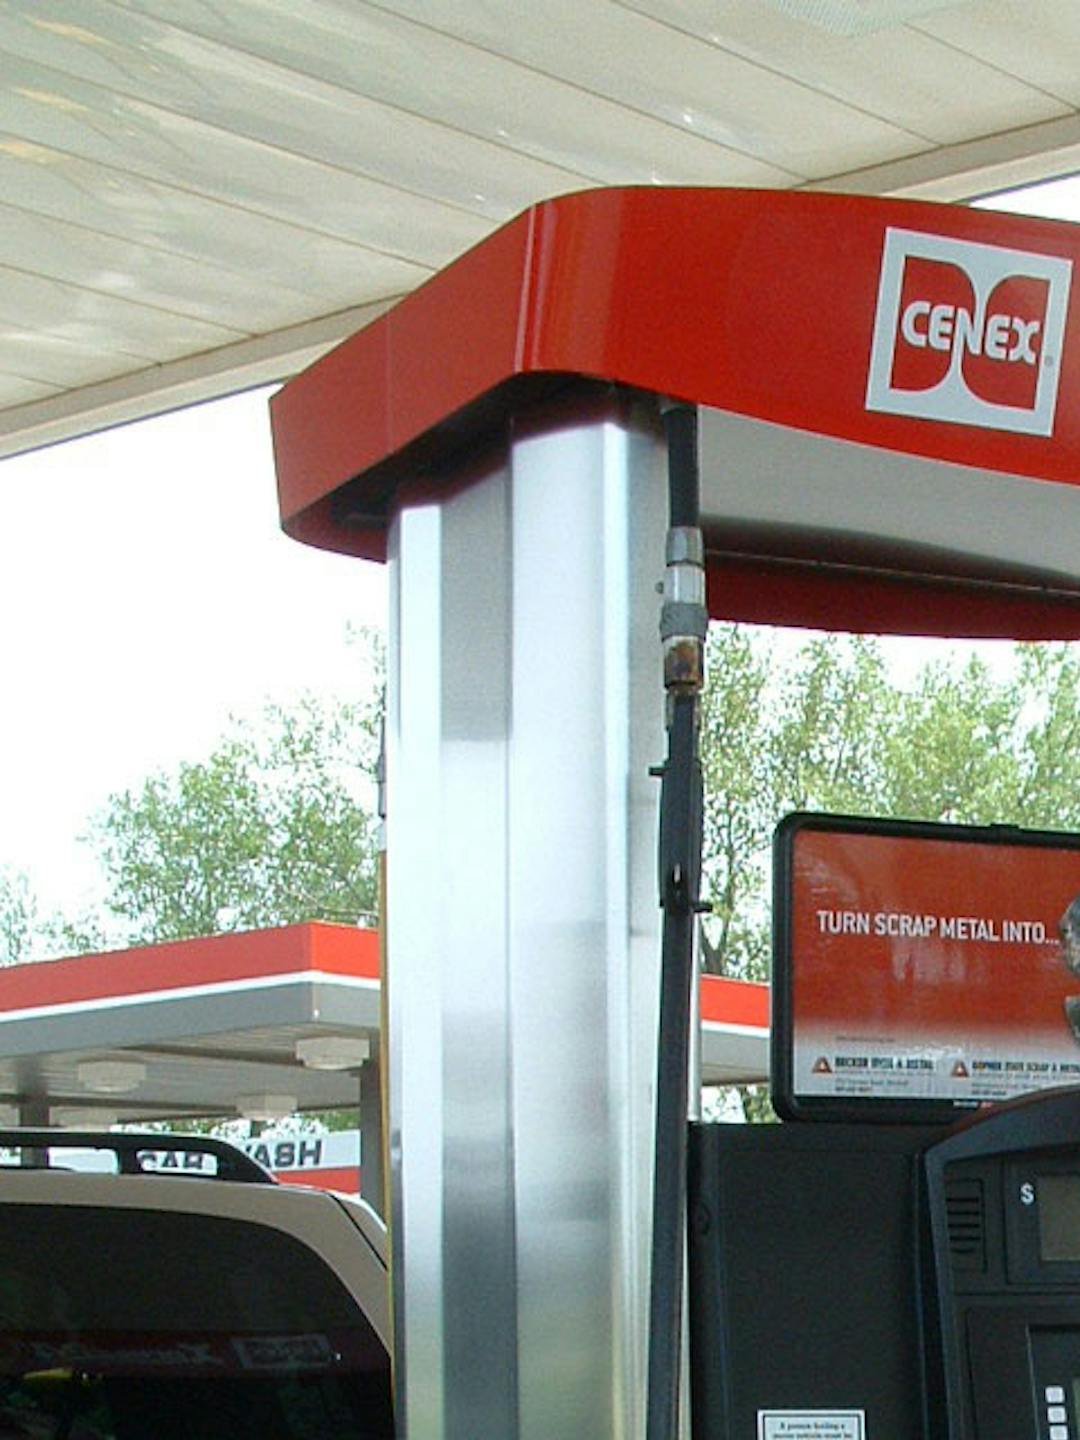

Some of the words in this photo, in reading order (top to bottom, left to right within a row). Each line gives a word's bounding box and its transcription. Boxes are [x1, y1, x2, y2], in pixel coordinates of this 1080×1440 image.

[902, 300, 1040, 366] CENEX
[817, 910, 869, 934] TURN
[874, 913, 937, 937] SCRAP
[940, 917, 999, 942] METAL
[1003, 921, 1060, 944] INTO...
[1020, 1182, 1035, 1206] $
